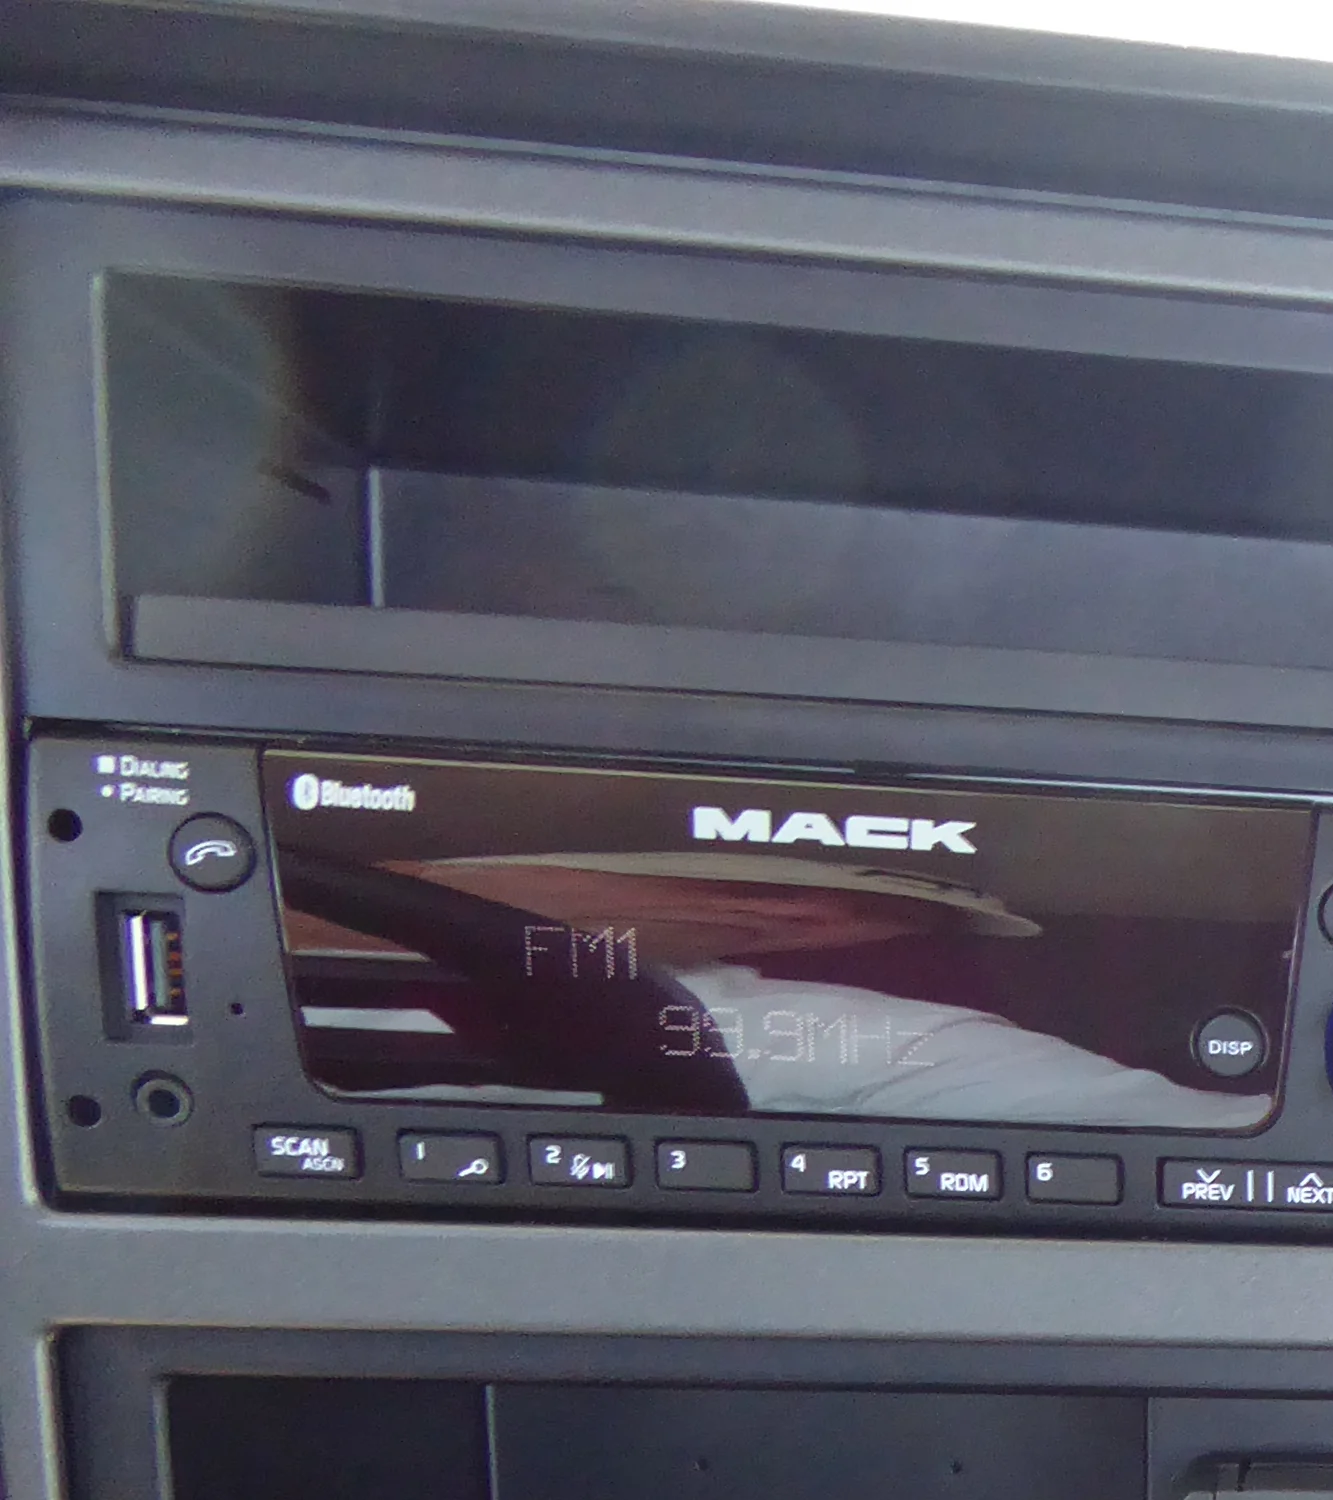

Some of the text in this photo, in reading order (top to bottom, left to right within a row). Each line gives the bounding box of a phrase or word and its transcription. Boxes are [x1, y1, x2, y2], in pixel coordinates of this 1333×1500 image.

[320, 779, 416, 812] Bluetooth
[692, 805, 978, 854] MACK
[1207, 1040, 1253, 1056] DISP
[271, 1137, 330, 1157] SCAN
[415, 1142, 426, 1160] 1
[545, 1144, 562, 1164] 2
[670, 1150, 687, 1170] 3
[791, 1154, 806, 1173] 4
[915, 1157, 931, 1176] 5
[828, 1169, 870, 1191] RPT
[940, 1172, 990, 1192] RDM
[1036, 1163, 1053, 1182] 6
[1182, 1181, 1234, 1201] PREV
